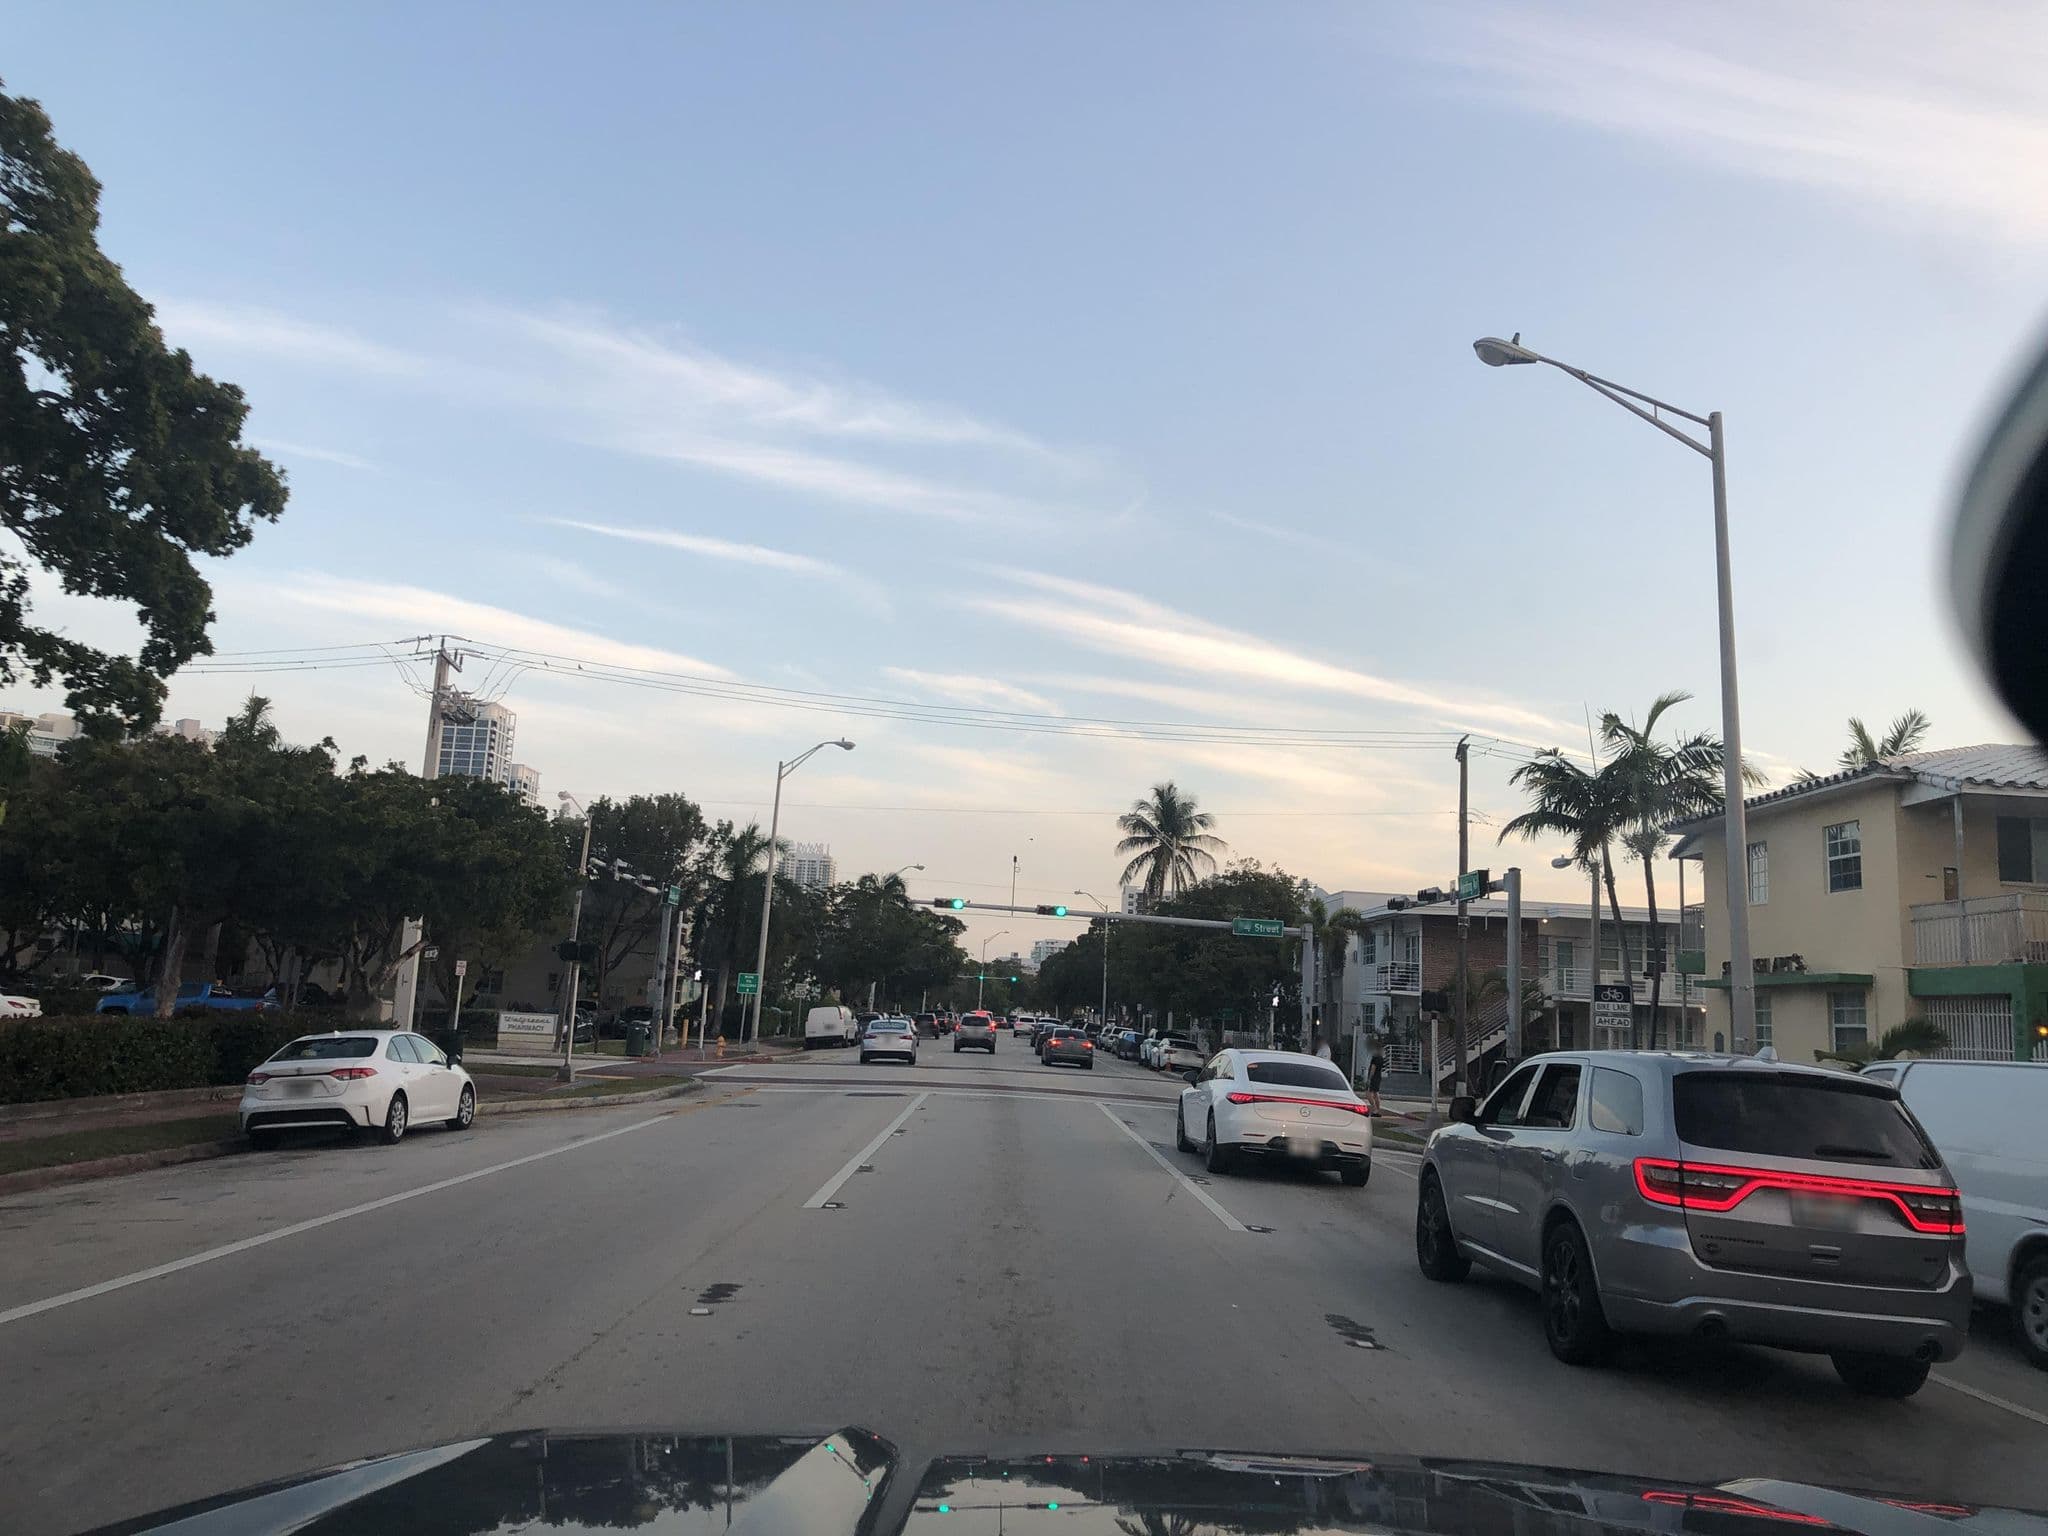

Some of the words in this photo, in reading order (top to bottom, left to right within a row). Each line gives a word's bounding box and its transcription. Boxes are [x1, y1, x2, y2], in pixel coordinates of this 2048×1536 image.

[1254, 923, 1279, 933] Street
[1596, 1003, 1610, 1011] BIKE
[1613, 1003, 1629, 1012] LANE
[1597, 1017, 1630, 1027] AHEAD
[507, 1023, 545, 1032] PHARMACY
